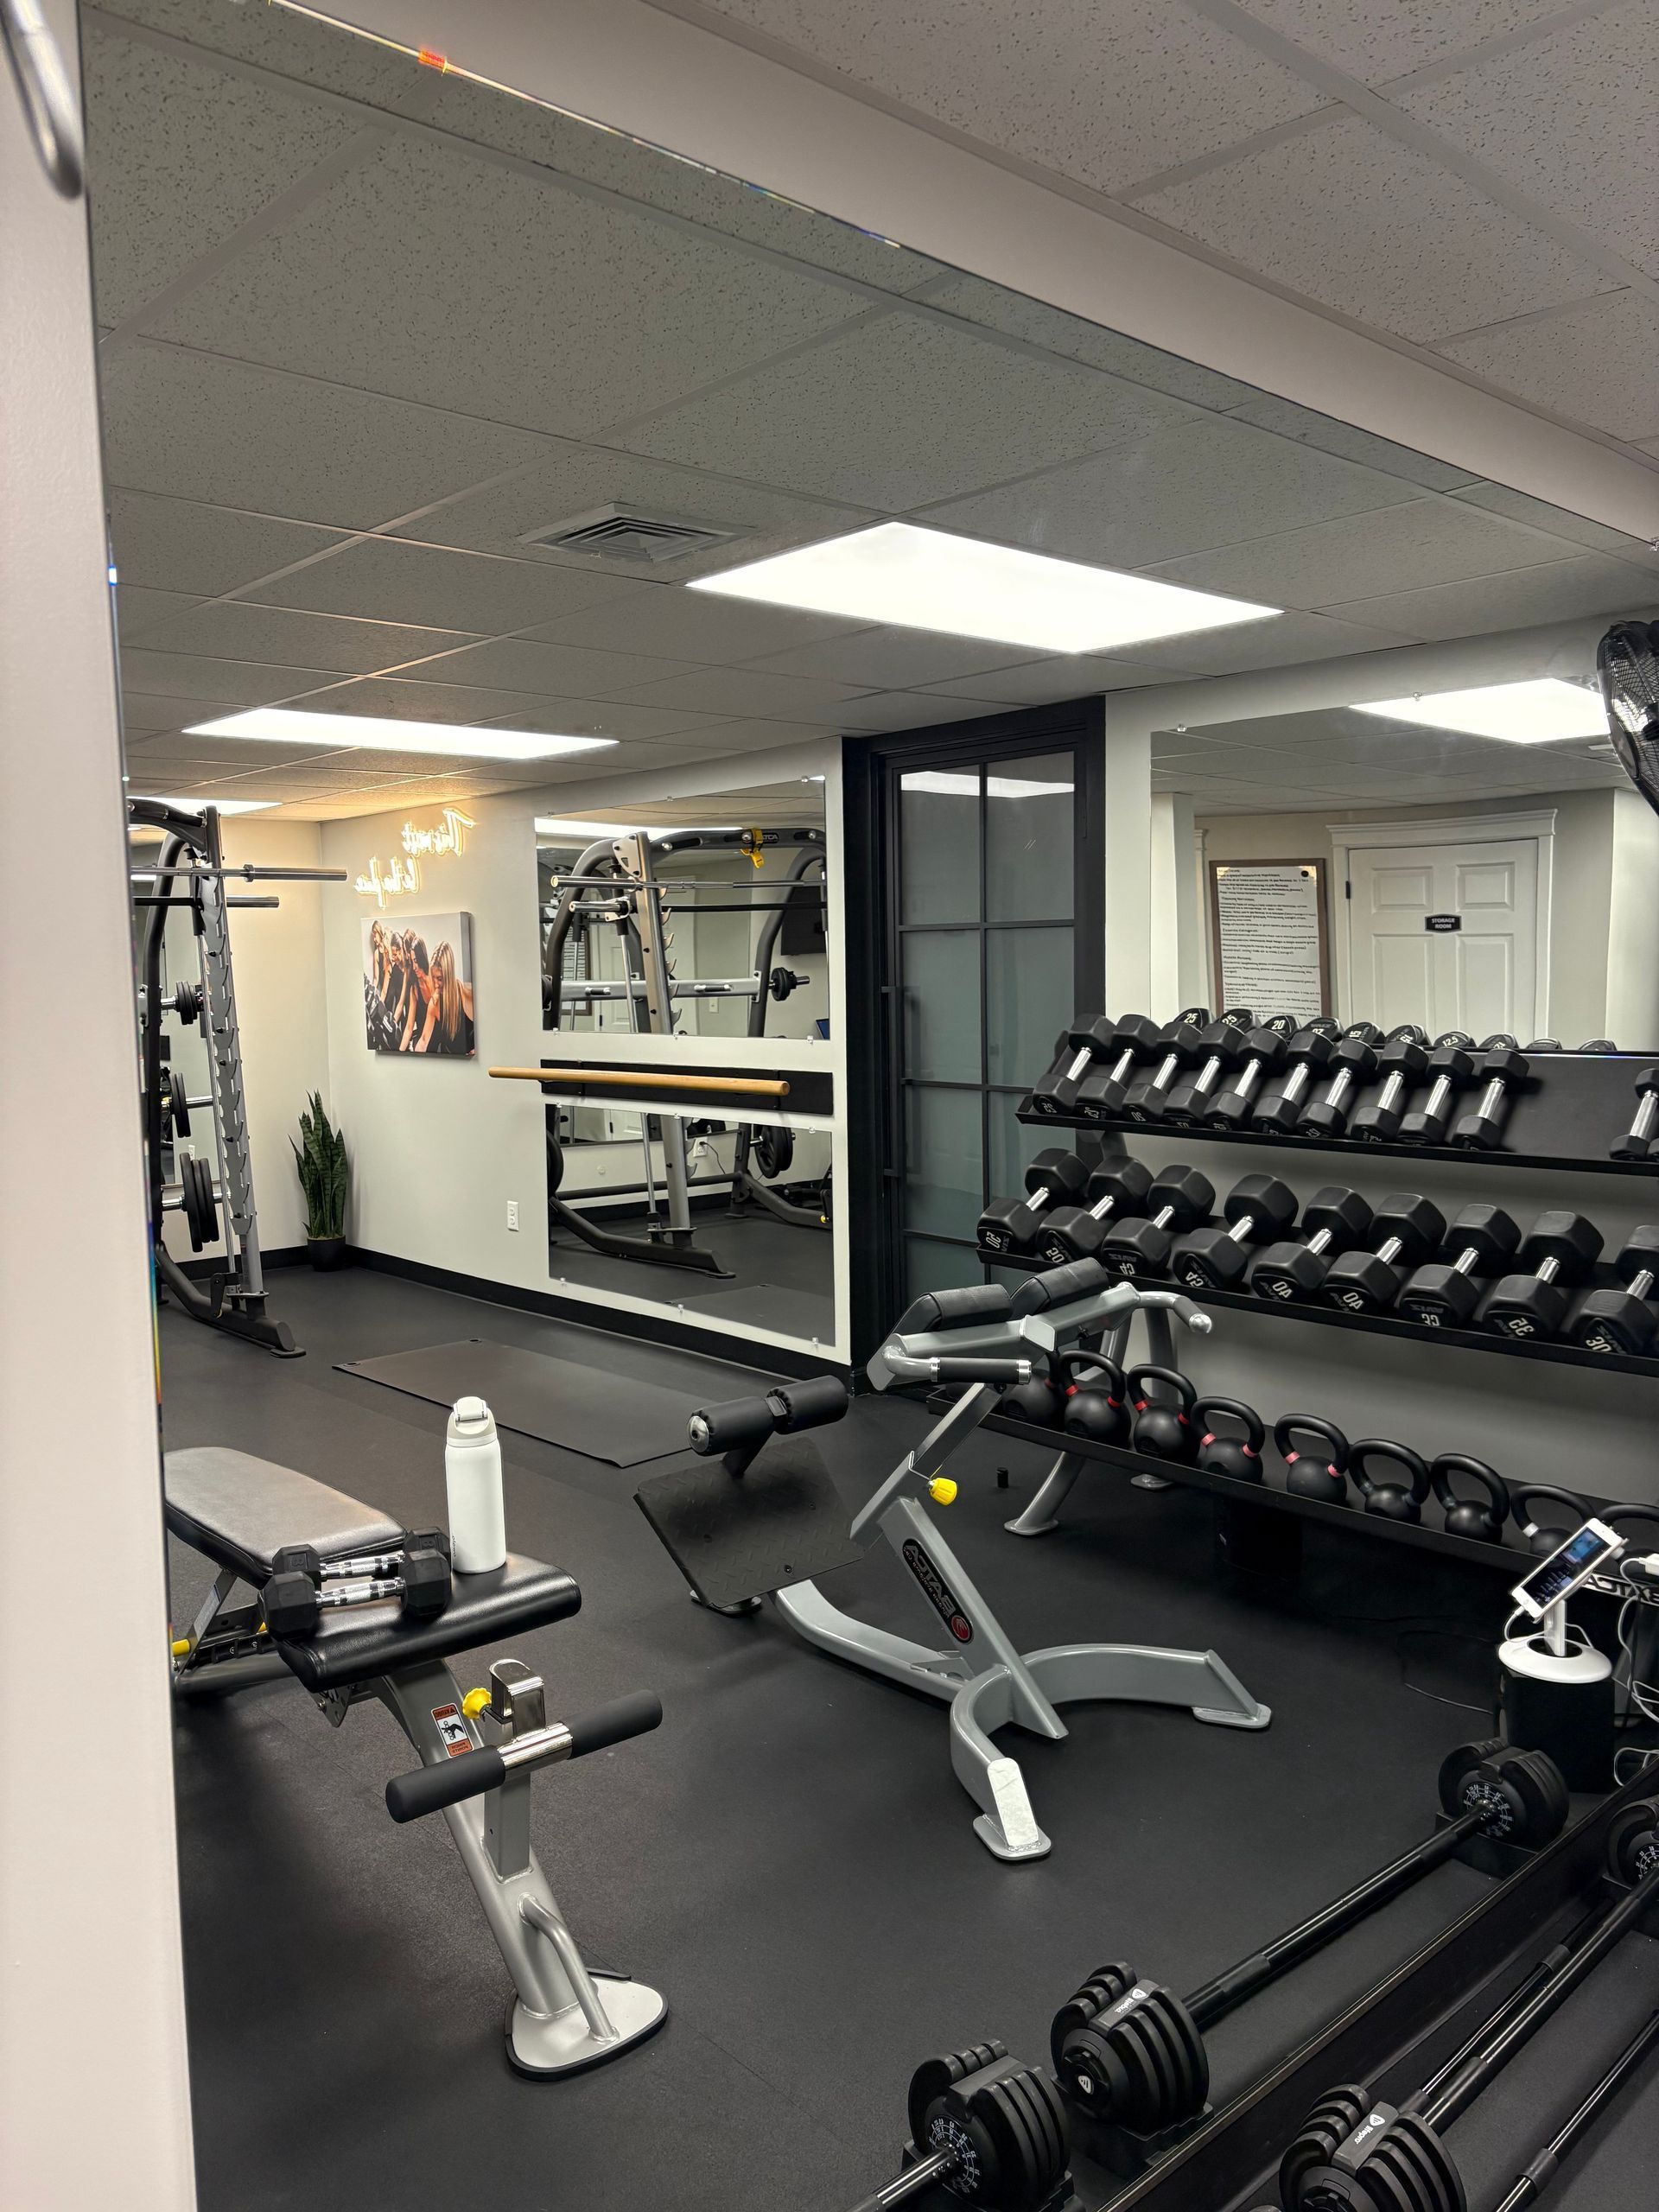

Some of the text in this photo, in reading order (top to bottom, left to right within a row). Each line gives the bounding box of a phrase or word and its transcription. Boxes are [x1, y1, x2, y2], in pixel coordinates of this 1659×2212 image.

[1184, 1013, 1198, 1024] 25
[1271, 1020, 1285, 1030] 20
[1442, 1036, 1459, 1047] 12.5
[1354, 2125, 1373, 2145] lifepro
